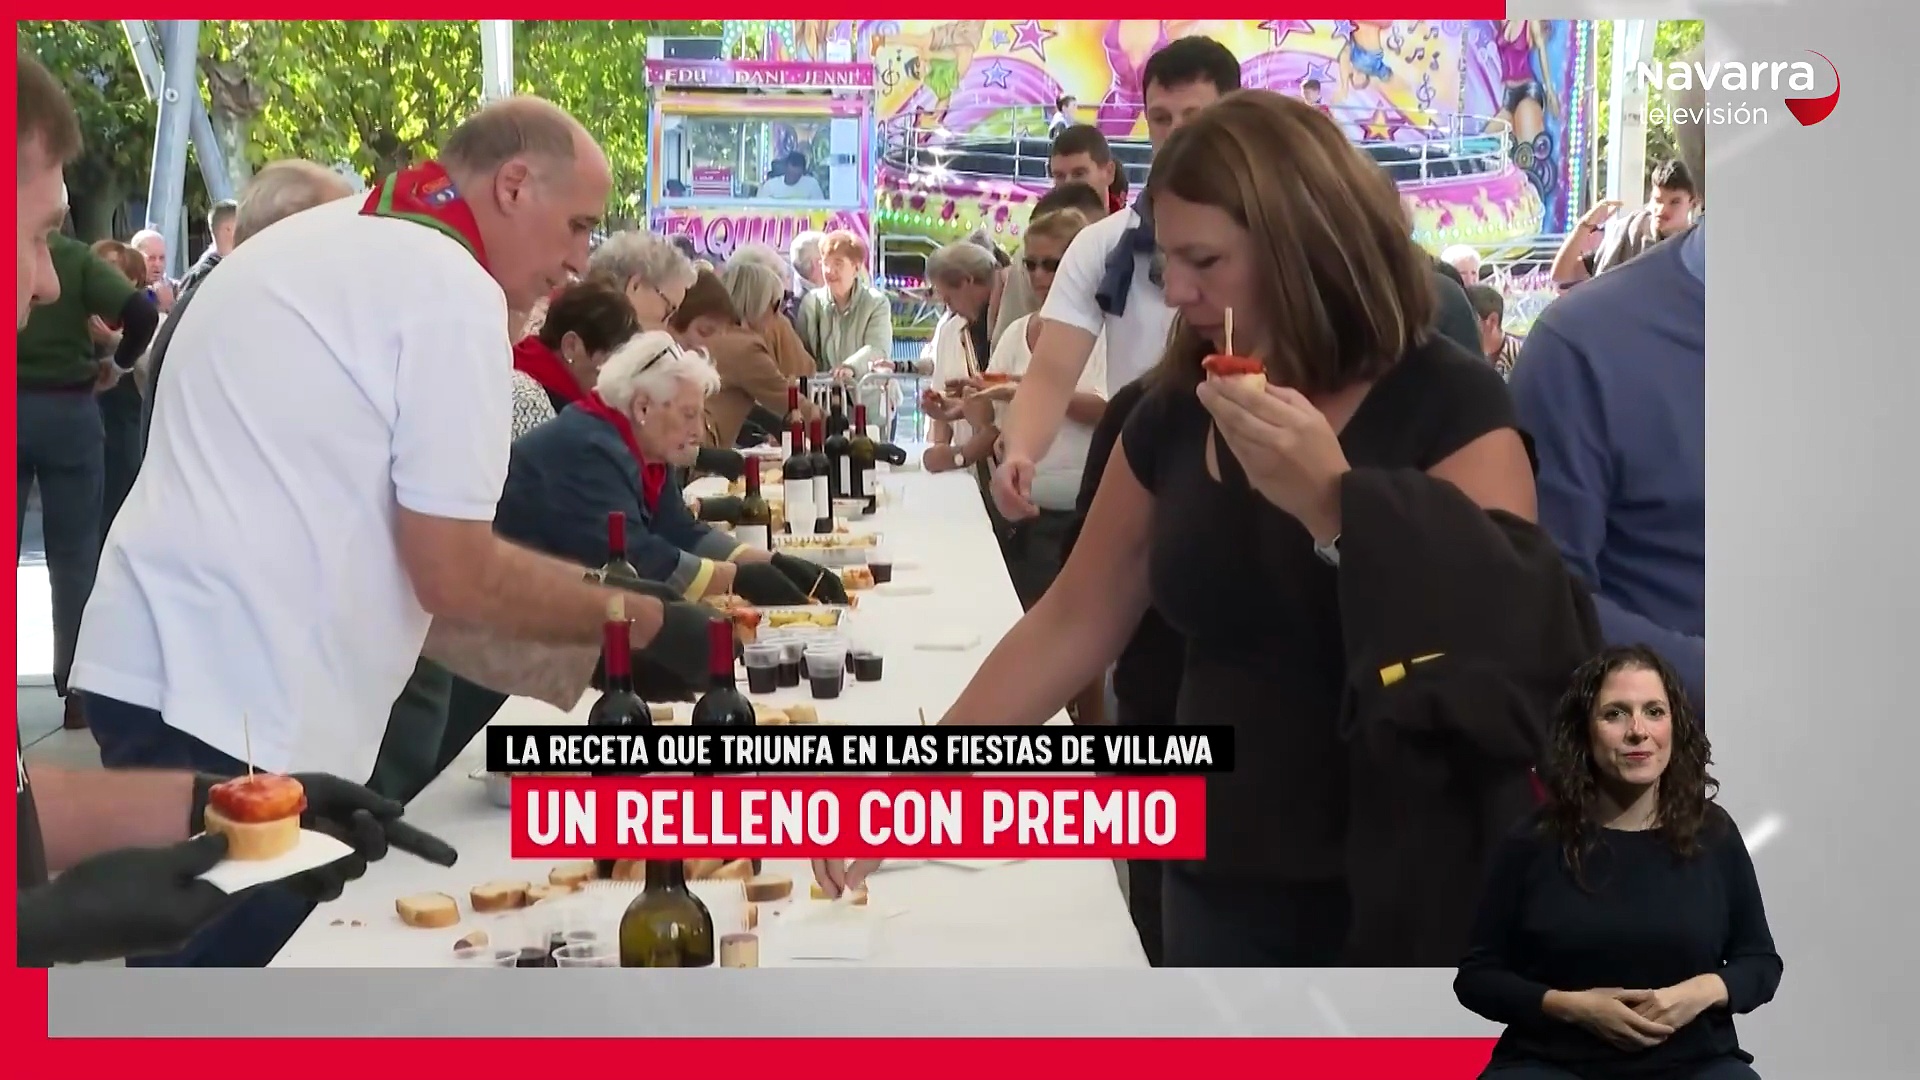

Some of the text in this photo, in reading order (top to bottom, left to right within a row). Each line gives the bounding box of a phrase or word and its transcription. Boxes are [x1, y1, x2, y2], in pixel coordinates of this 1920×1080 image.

[665, 69, 854, 85] EDU DANI JENNI
